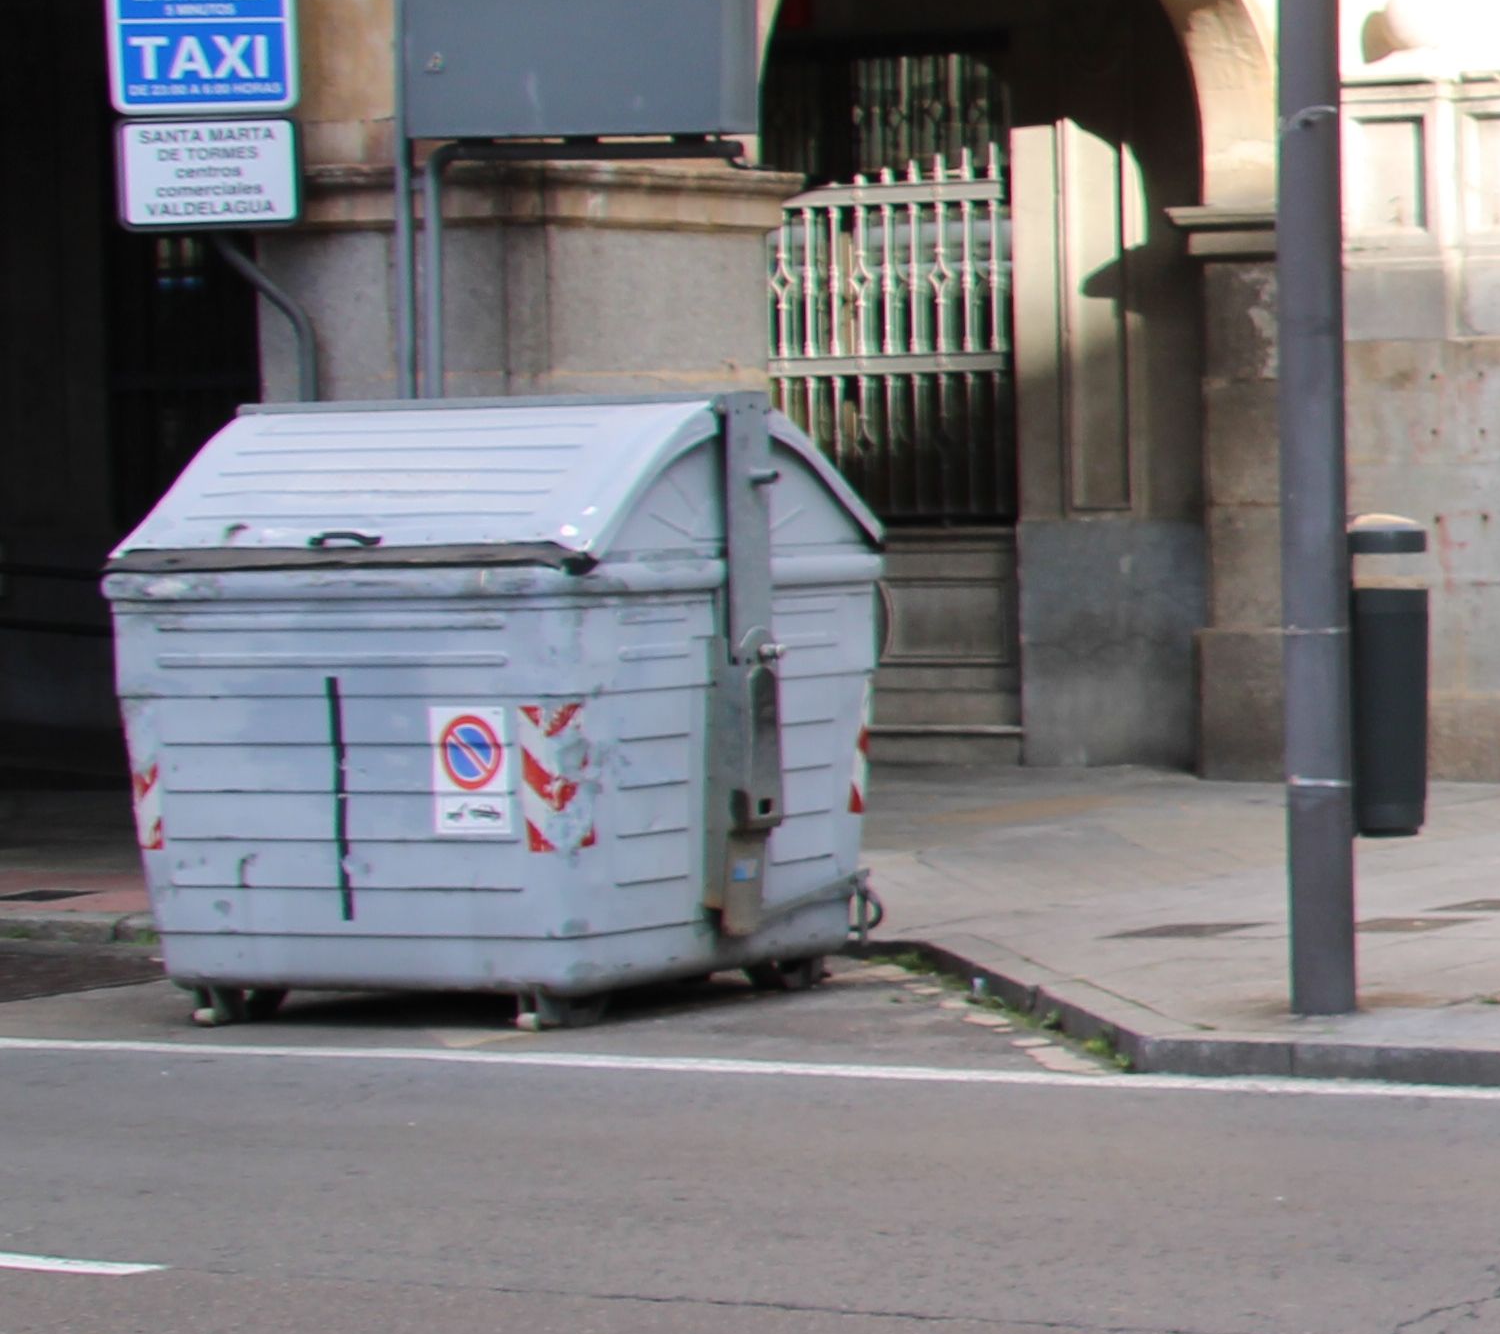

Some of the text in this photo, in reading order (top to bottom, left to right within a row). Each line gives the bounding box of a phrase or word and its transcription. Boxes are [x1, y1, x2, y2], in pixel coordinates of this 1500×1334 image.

[176, 3, 237, 16] MINUTOS
[127, 34, 270, 80] TAXI
[128, 85, 148, 96] DE
[233, 82, 282, 94] HORAS
[139, 127, 275, 144] SANTA MARTA
[157, 146, 259, 162] DE TORMES
[175, 166, 243, 180] centros
[155, 182, 264, 198] comerciales
[145, 200, 277, 216] VALDELAGUA
